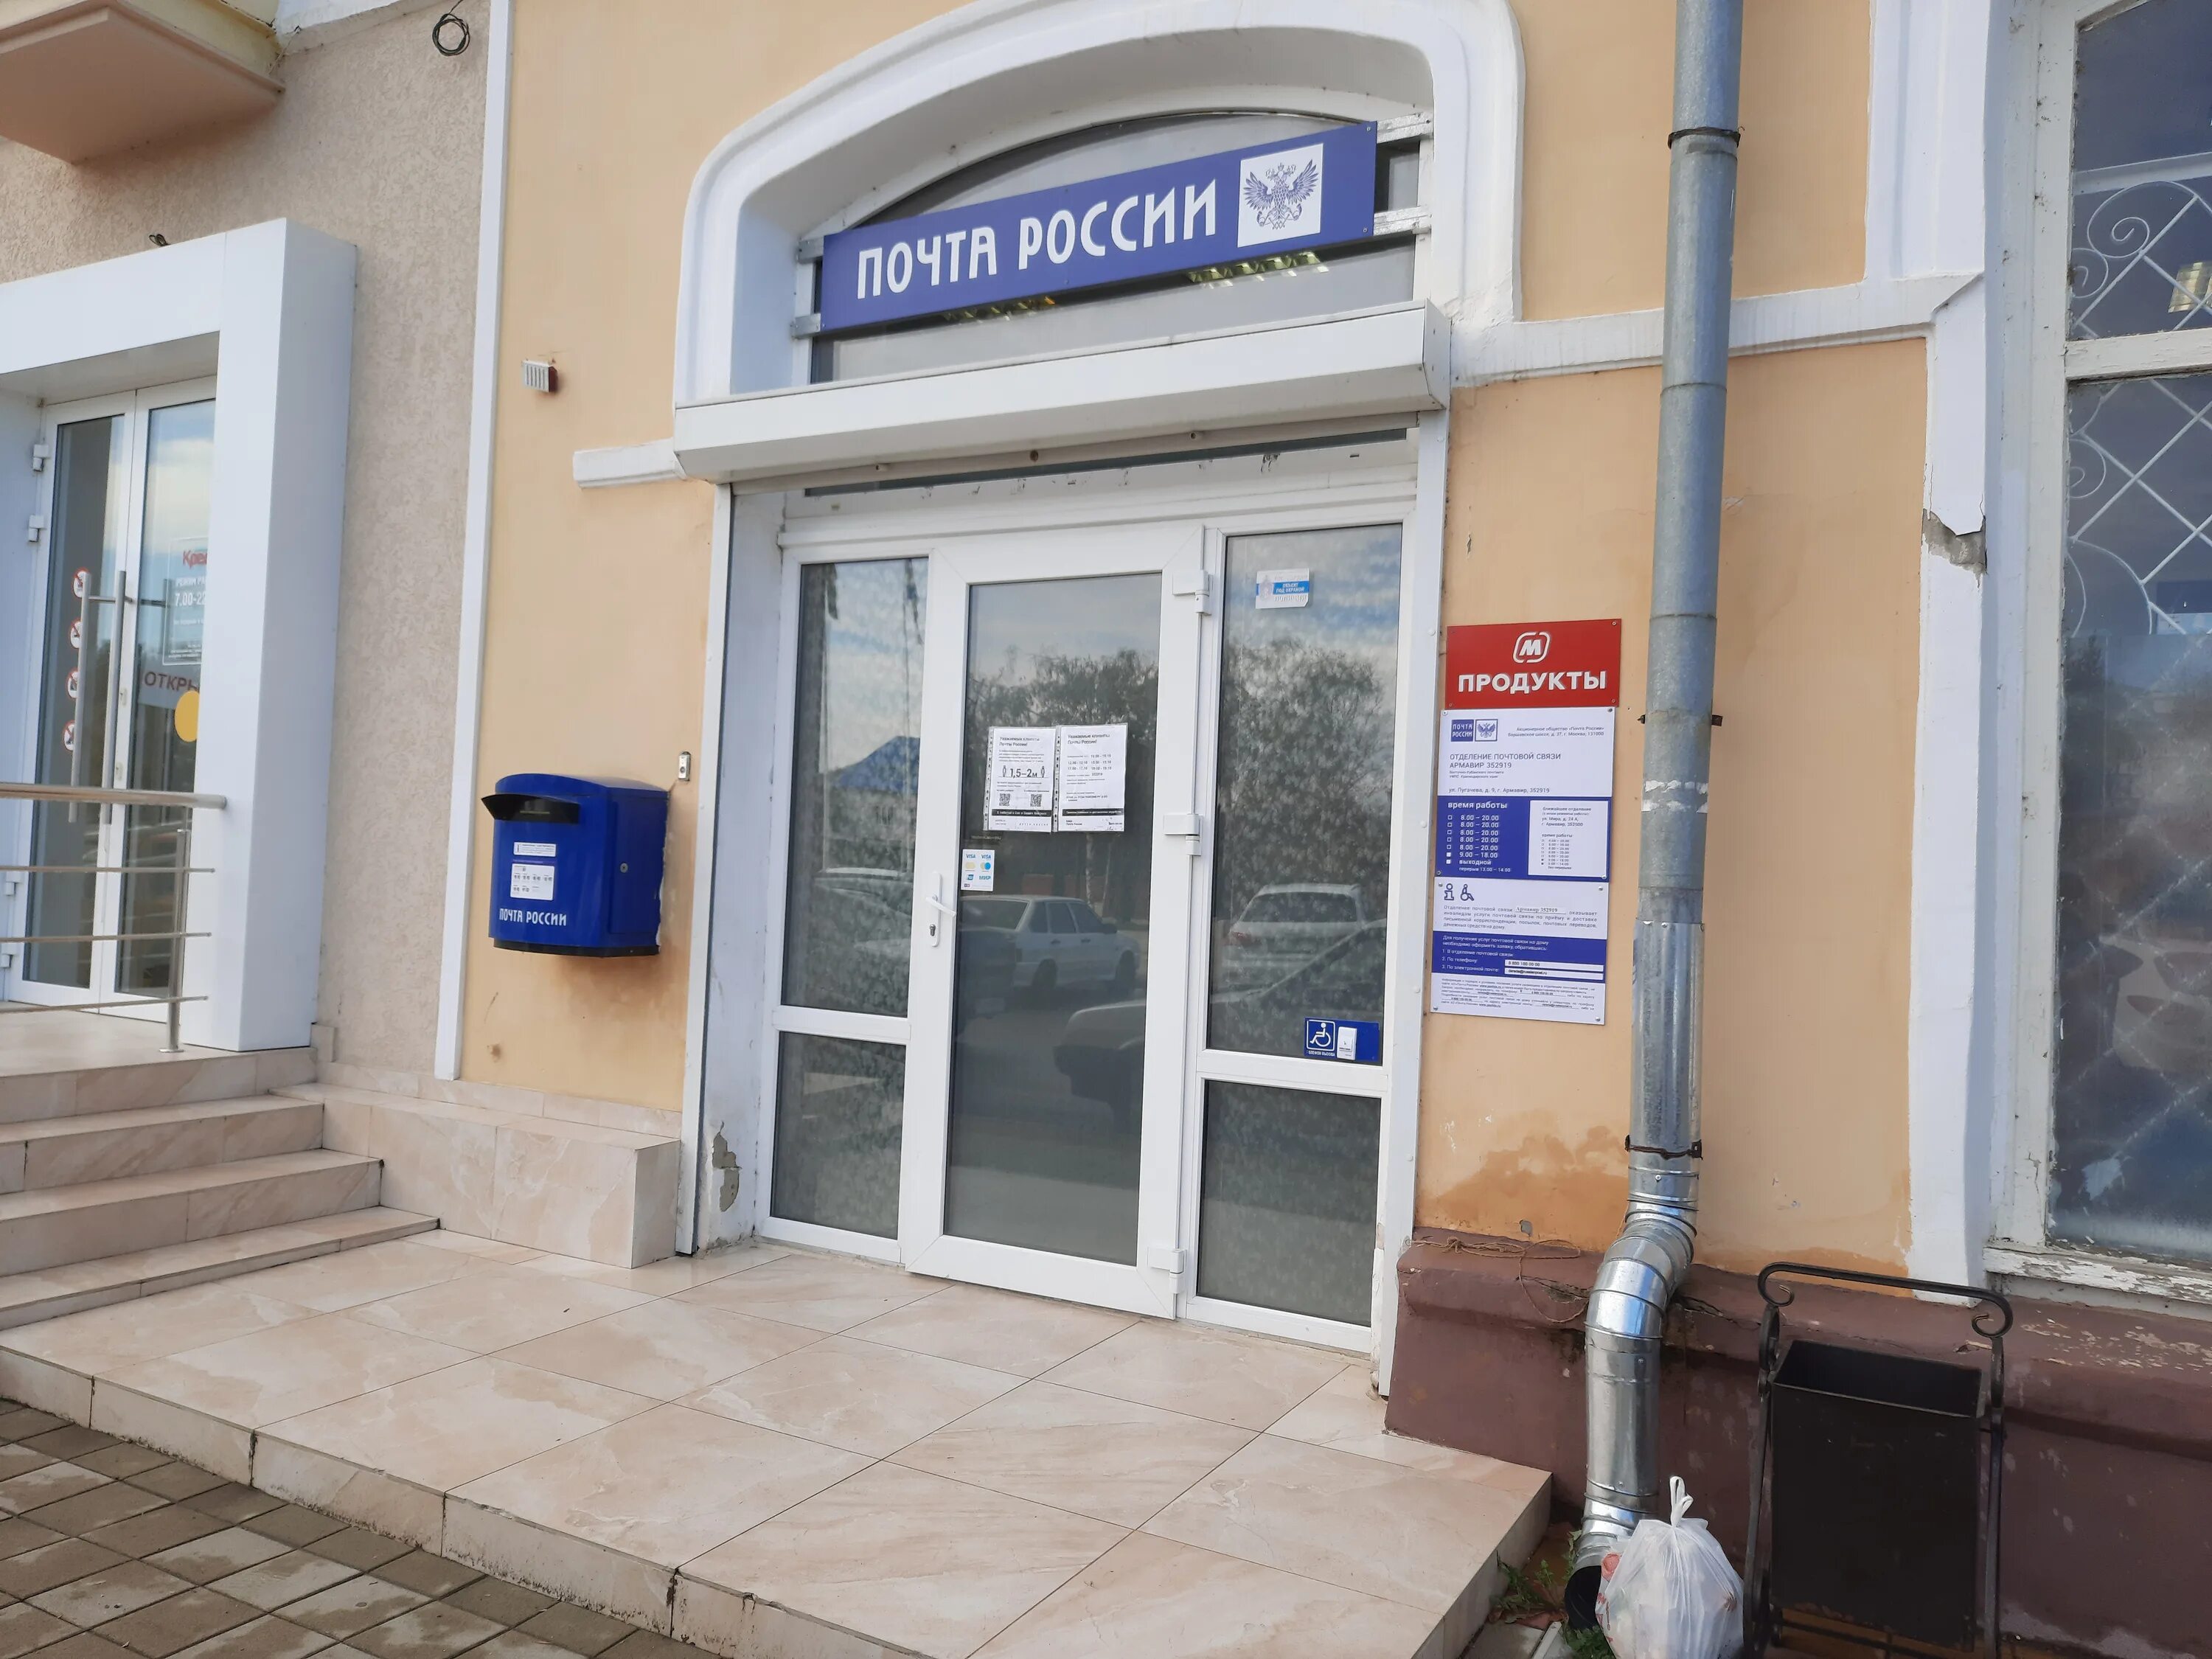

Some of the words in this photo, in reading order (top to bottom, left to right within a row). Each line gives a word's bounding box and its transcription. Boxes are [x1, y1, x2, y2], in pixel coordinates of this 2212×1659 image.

[858, 226, 997, 300] ПОЧТА
[1018, 178, 1217, 270] РОССИИ
[1458, 671, 1607, 694] ПРОДУКТЫ
[1475, 801, 1507, 810] работы
[499, 908, 523, 923] ПОЧТА
[526, 911, 567, 927] РОССИИ
